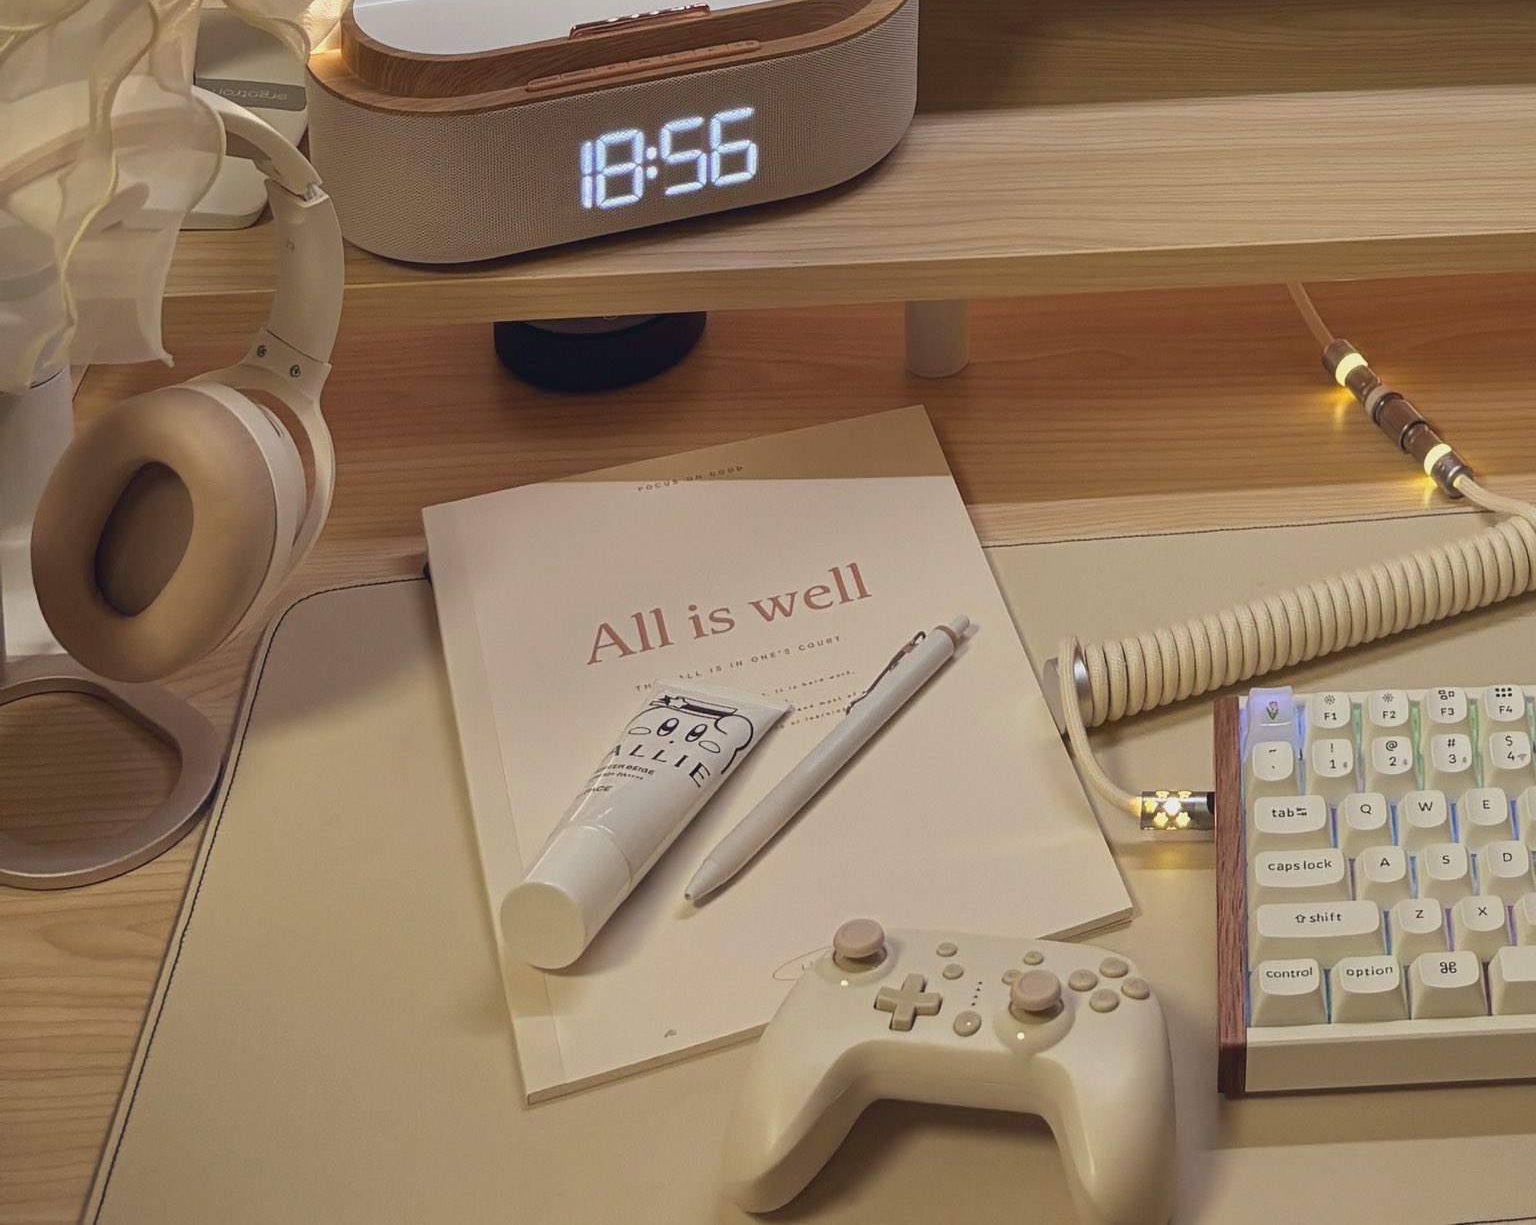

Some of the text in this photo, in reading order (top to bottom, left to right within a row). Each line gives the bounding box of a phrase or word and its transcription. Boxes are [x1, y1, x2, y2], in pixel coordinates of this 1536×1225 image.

[580, 106, 757, 210] 18:56
[637, 478, 679, 492] FOCUS
[586, 562, 872, 665] All is well
[634, 682, 652, 692] TH
[709, 665, 722, 673] IS
[730, 660, 743, 669] IN
[751, 648, 791, 663] ONE'S
[1382, 710, 1397, 720] F2
[1440, 707, 1455, 717] F3
[1498, 705, 1513, 714] F4
[1323, 712, 1337, 721] F1
[1388, 756, 1397, 767] 2
[1448, 753, 1457, 764] 3
[1506, 751, 1516, 761] 4
[601, 744, 711, 788] ALLIE
[1329, 759, 1337, 769] 1
[1359, 803, 1372, 815] Q
[1417, 801, 1433, 812] W
[1482, 799, 1491, 810] E
[1271, 807, 1295, 818] tab
[1379, 857, 1391, 868] A
[1442, 854, 1450, 865] S
[1502, 852, 1513, 863] D
[1267, 858, 1332, 873] caps lock
[1415, 909, 1424, 919] Z
[1477, 906, 1488, 917] X
[1309, 912, 1342, 923] shift
[1265, 966, 1313, 979] control
[1346, 965, 1393, 978] option
